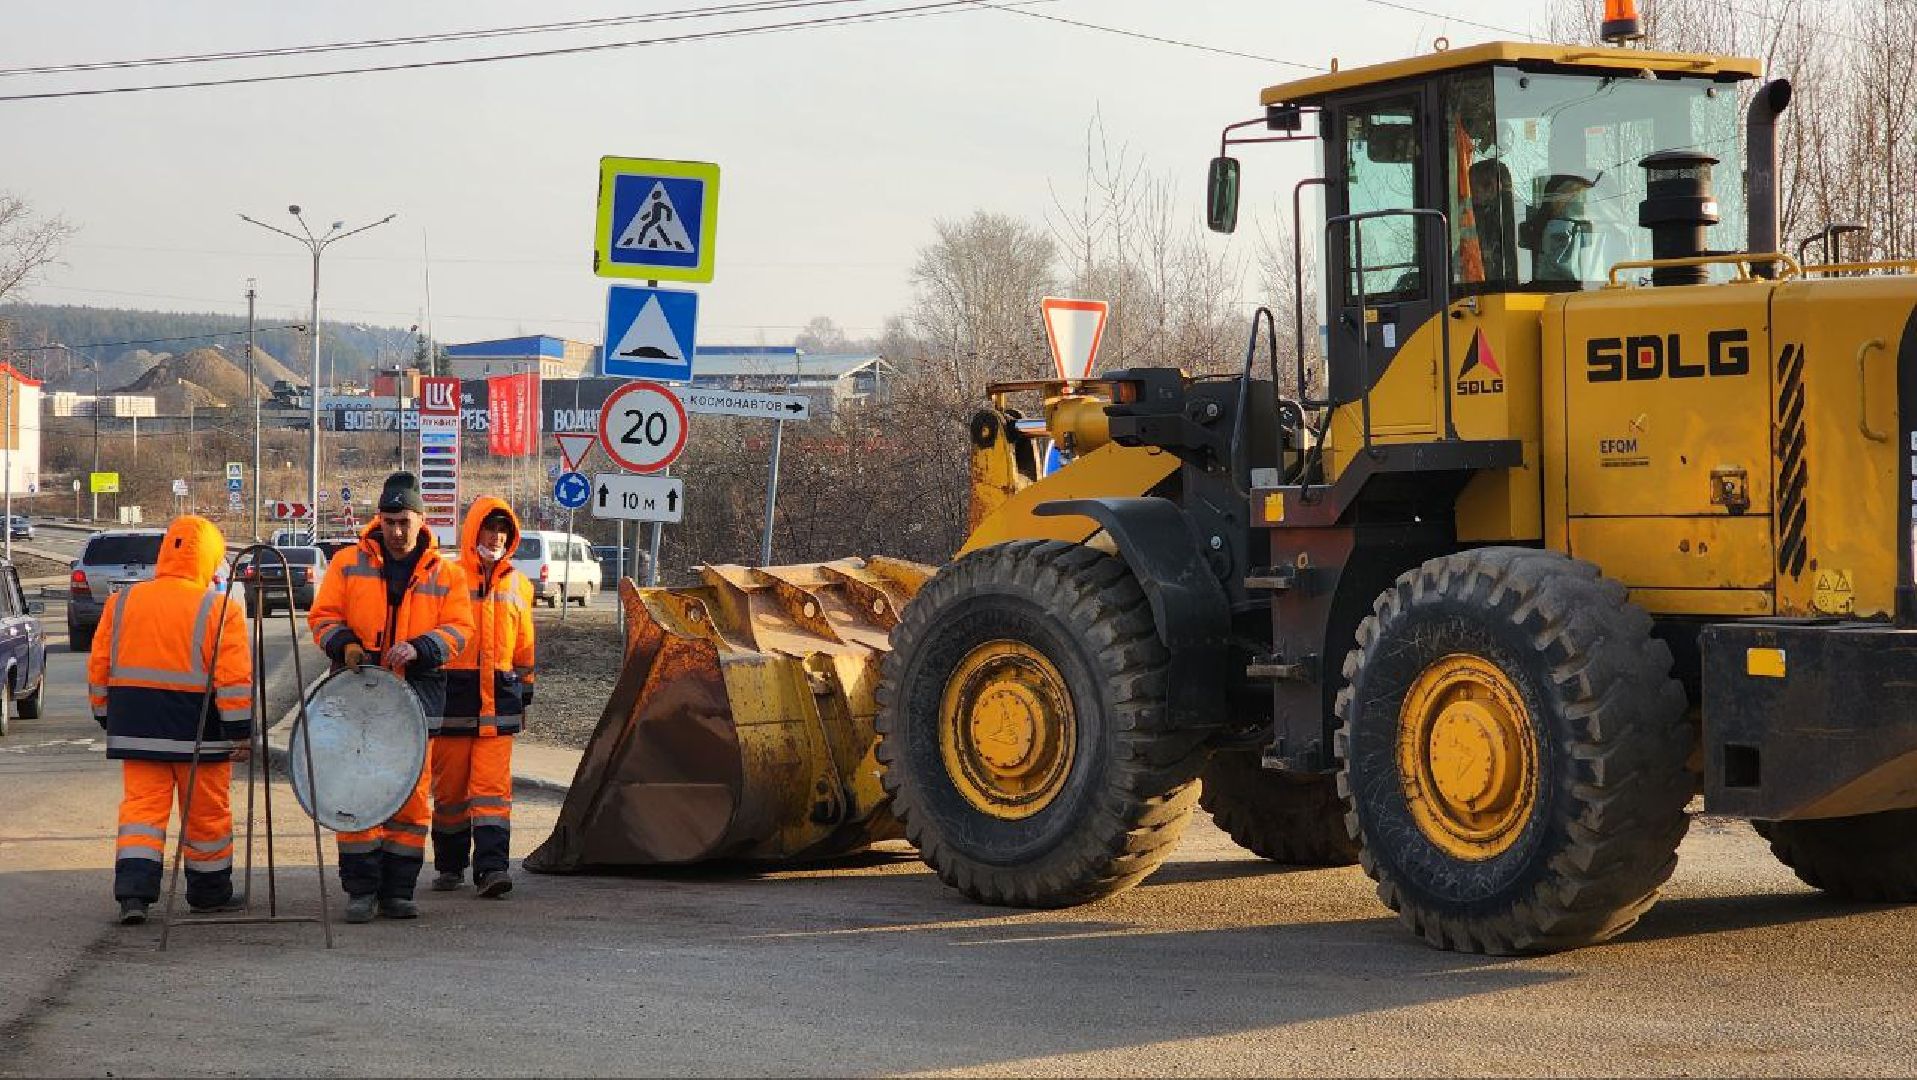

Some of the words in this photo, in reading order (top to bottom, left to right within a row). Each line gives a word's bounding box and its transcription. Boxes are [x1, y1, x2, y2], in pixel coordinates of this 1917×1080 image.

[1587, 329, 1749, 383] SDLG
[1457, 380, 1503, 395] SDLG
[690, 395, 782, 412] КОСМОНАВТОВ
[620, 409, 667, 446] 20
[1600, 440, 1637, 453] EFQM
[622, 492, 639, 510] 10
